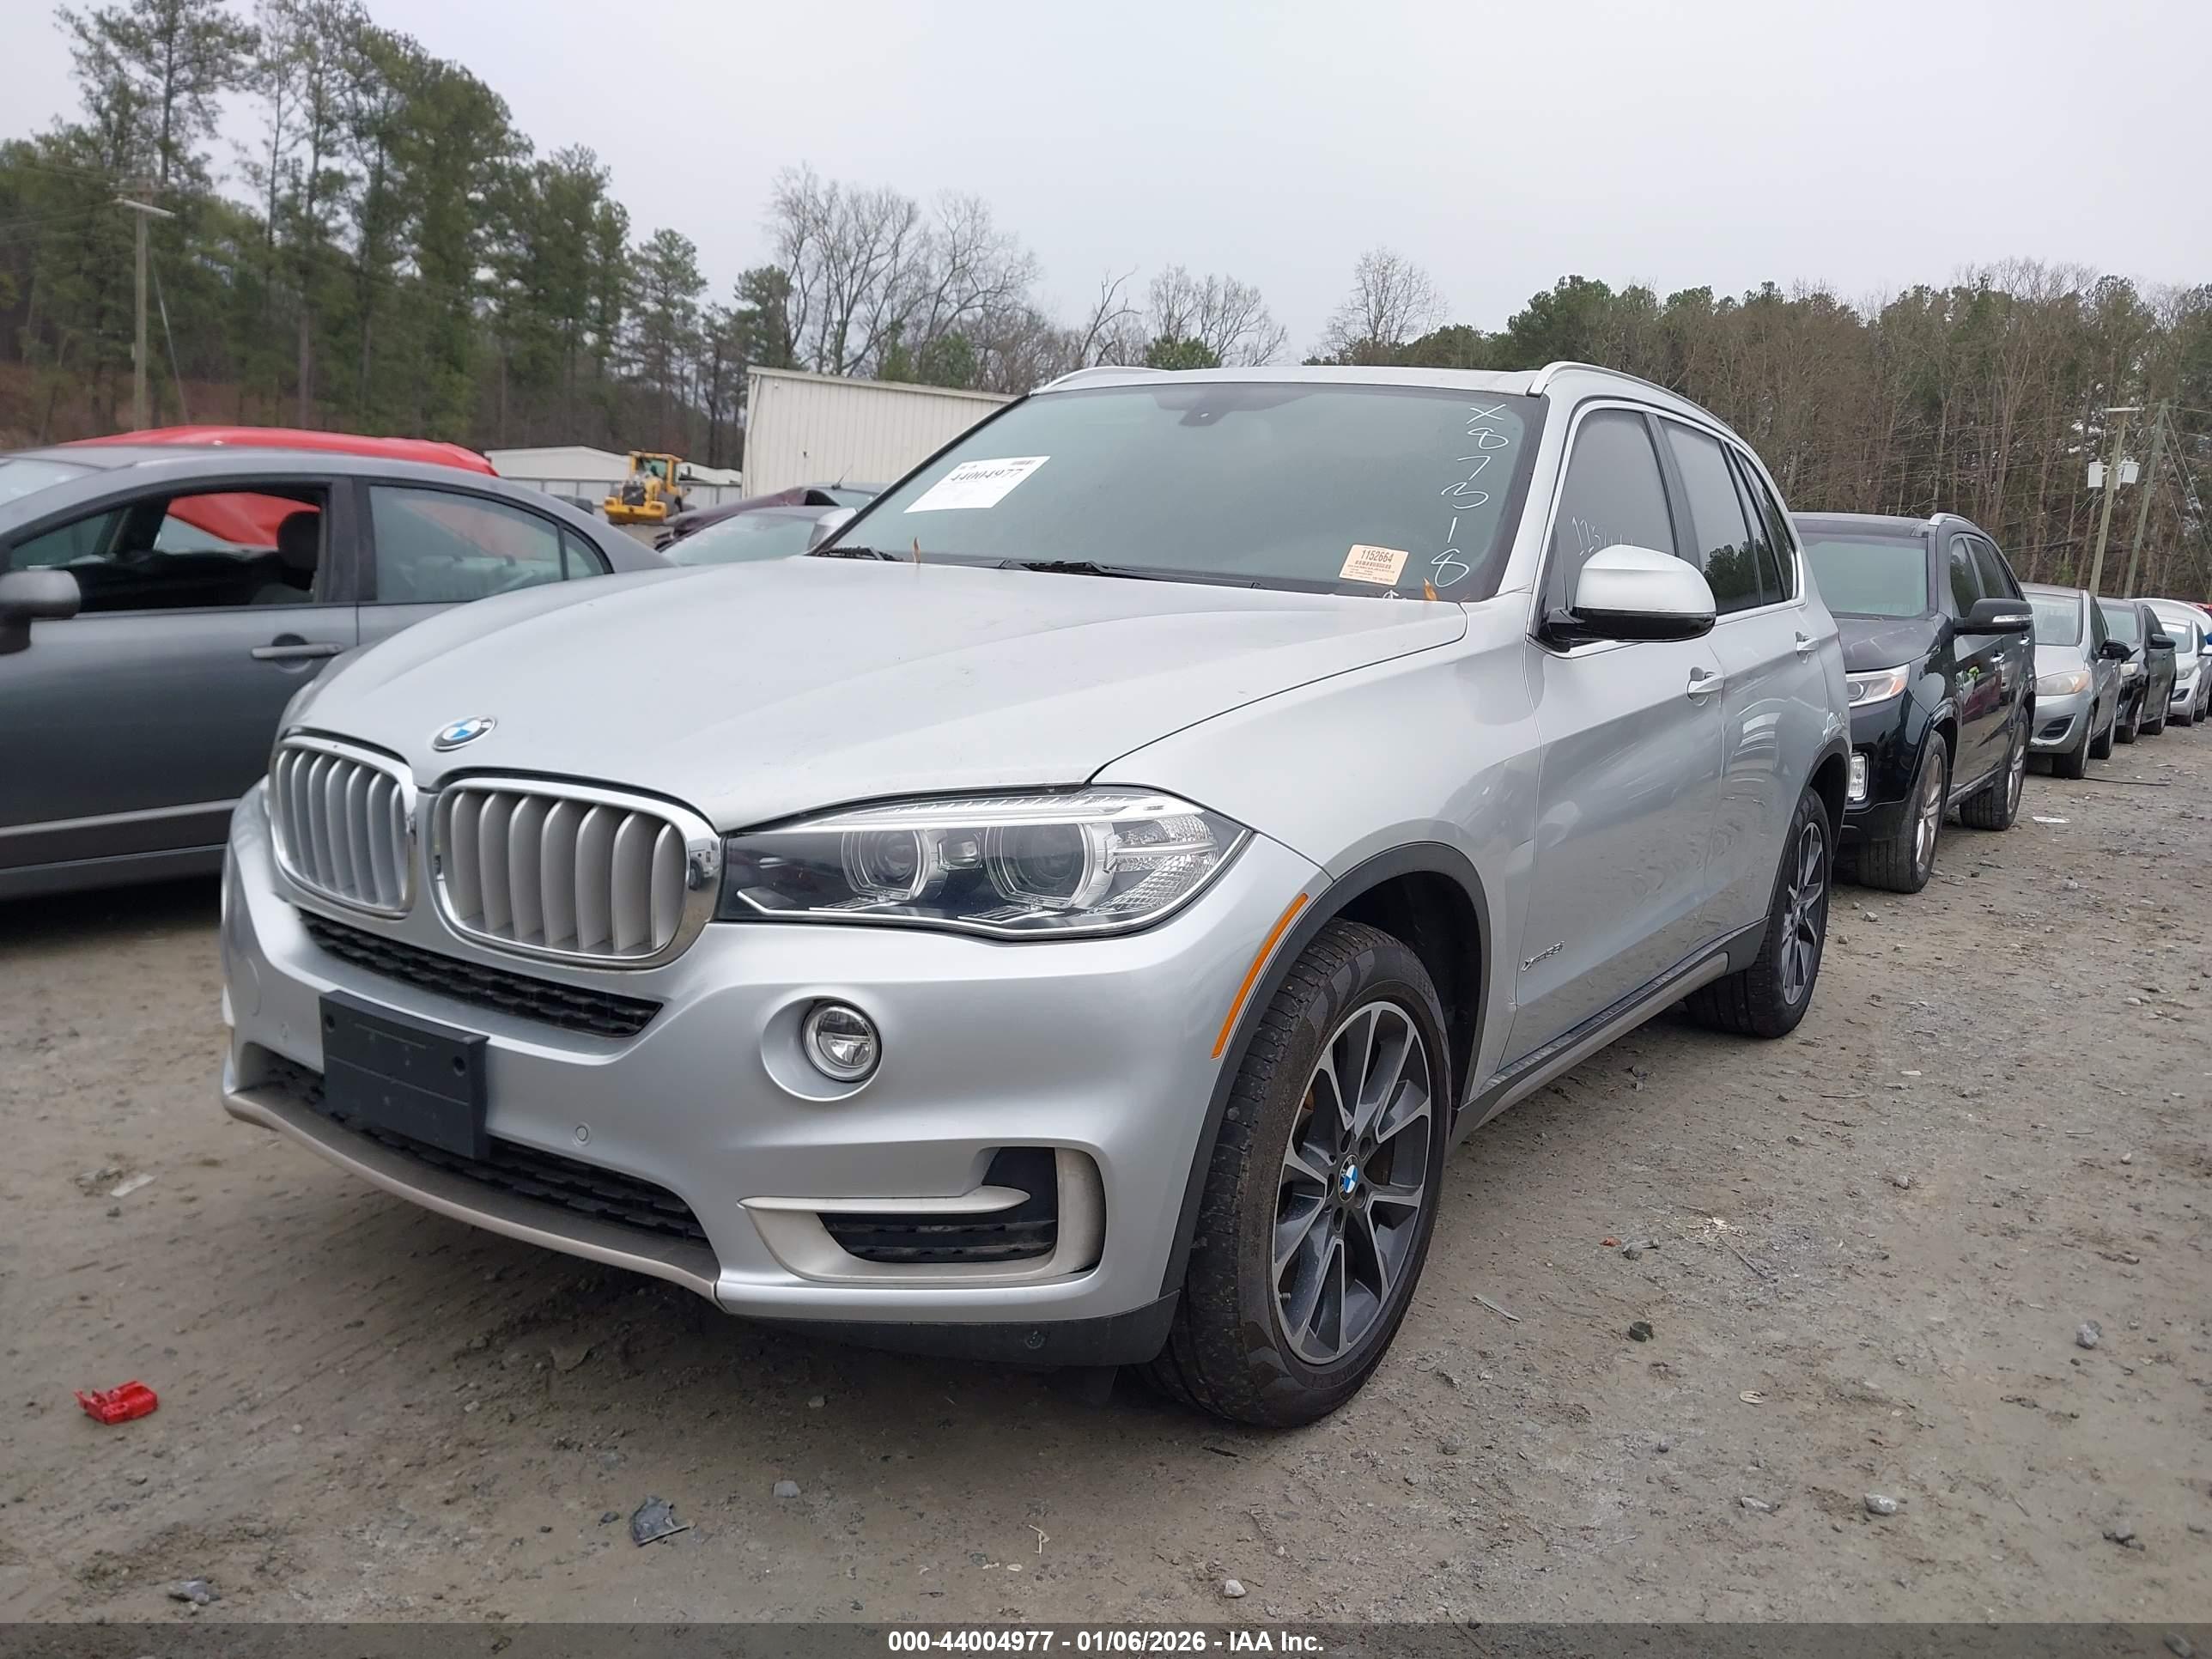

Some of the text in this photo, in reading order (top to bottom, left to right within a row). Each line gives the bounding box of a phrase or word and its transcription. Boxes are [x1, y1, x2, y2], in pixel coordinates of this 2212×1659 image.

[951, 468, 1024, 481] 44004977
[1431, 404, 1509, 587] X87318
[1361, 550, 1394, 562] 1152664
